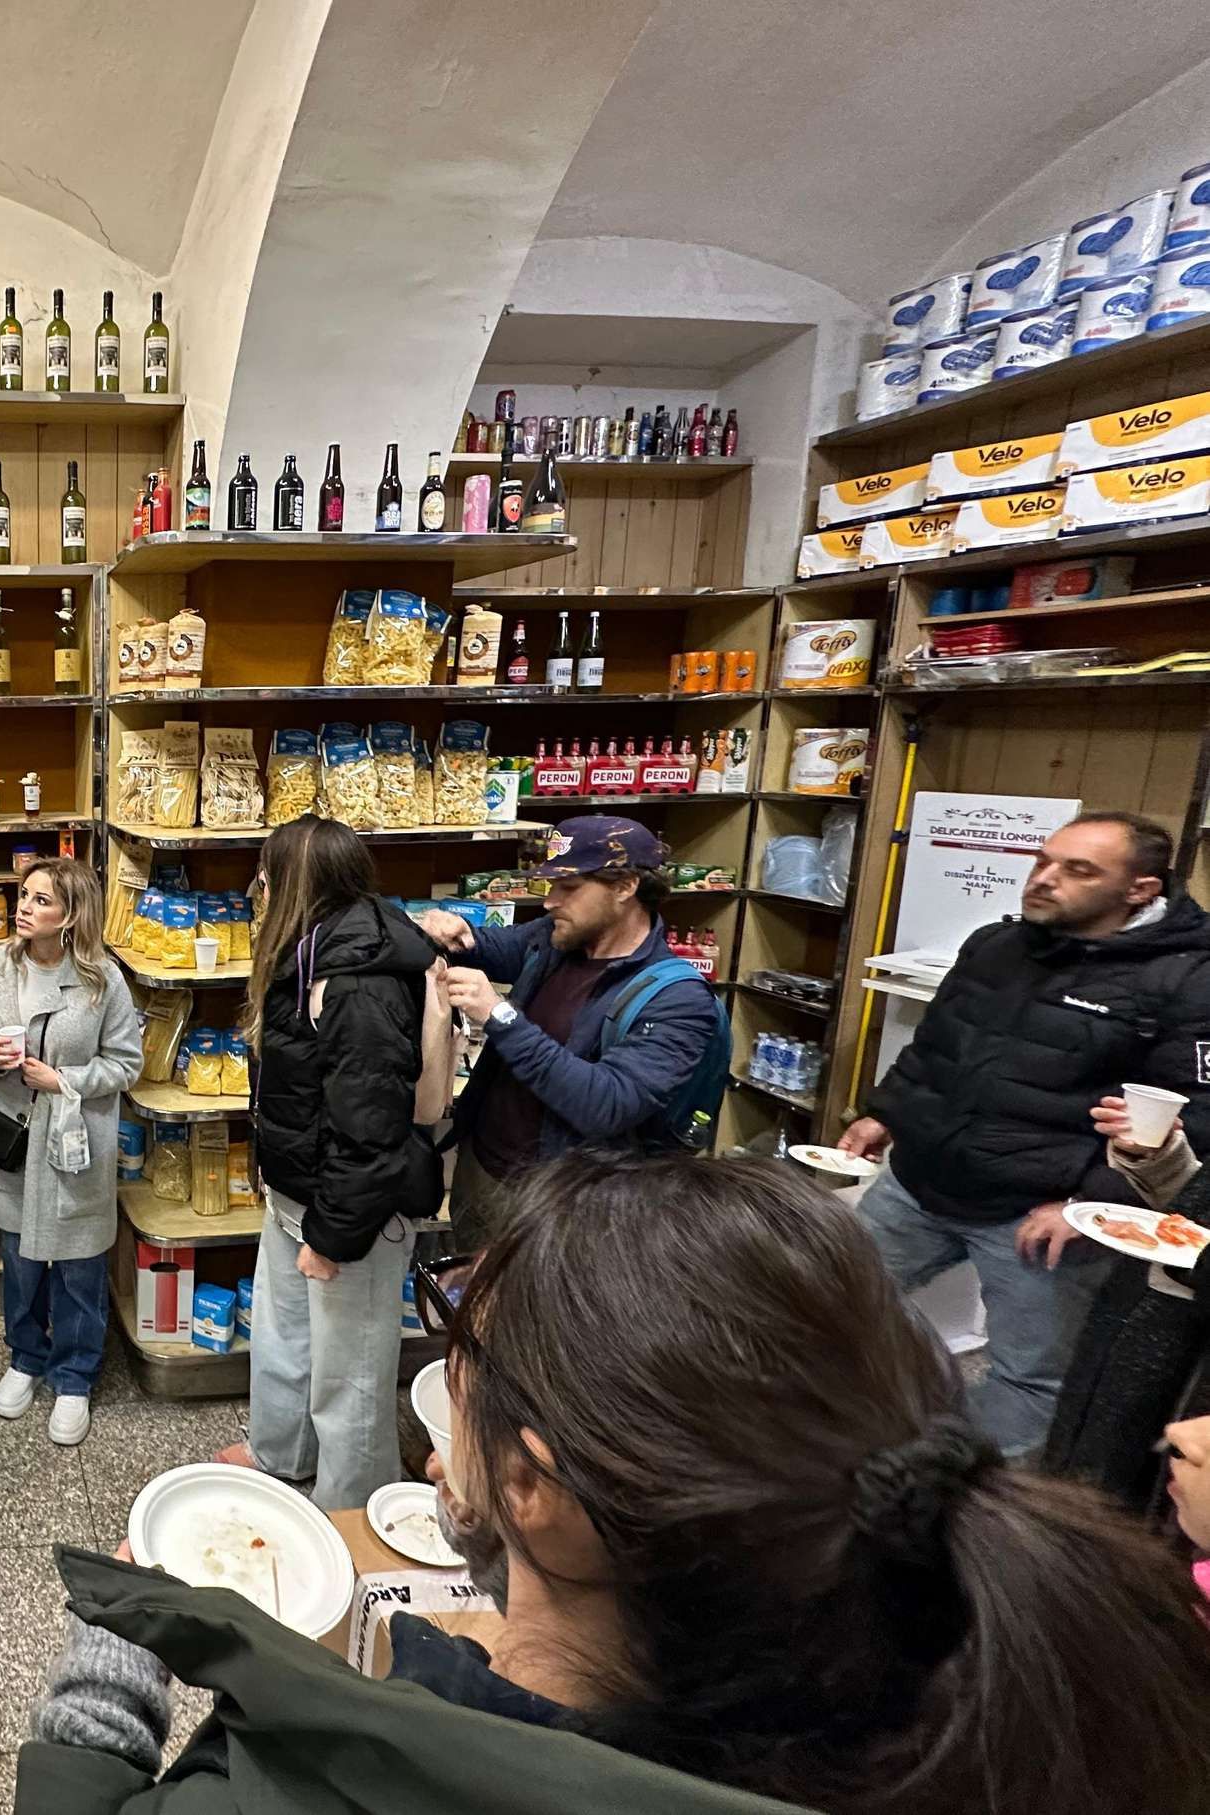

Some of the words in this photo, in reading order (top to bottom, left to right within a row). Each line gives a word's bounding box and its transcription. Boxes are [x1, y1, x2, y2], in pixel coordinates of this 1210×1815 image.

[1119, 409, 1172, 431] Velo
[978, 445, 1023, 463] Velo
[855, 476, 892, 492] Velo
[1128, 468, 1185, 488] Velo
[1007, 496, 1056, 514] Velo
[908, 517, 950, 534] Velo
[841, 533, 863, 547] Ve
[539, 773, 580, 784] PERONI
[593, 771, 633, 782] PERONI
[645, 770, 688, 781] PERONI
[930, 825, 998, 841] DELICATEZZE
[944, 870, 1016, 886] DISINFETTANTE
[966, 881, 990, 890] MANI
